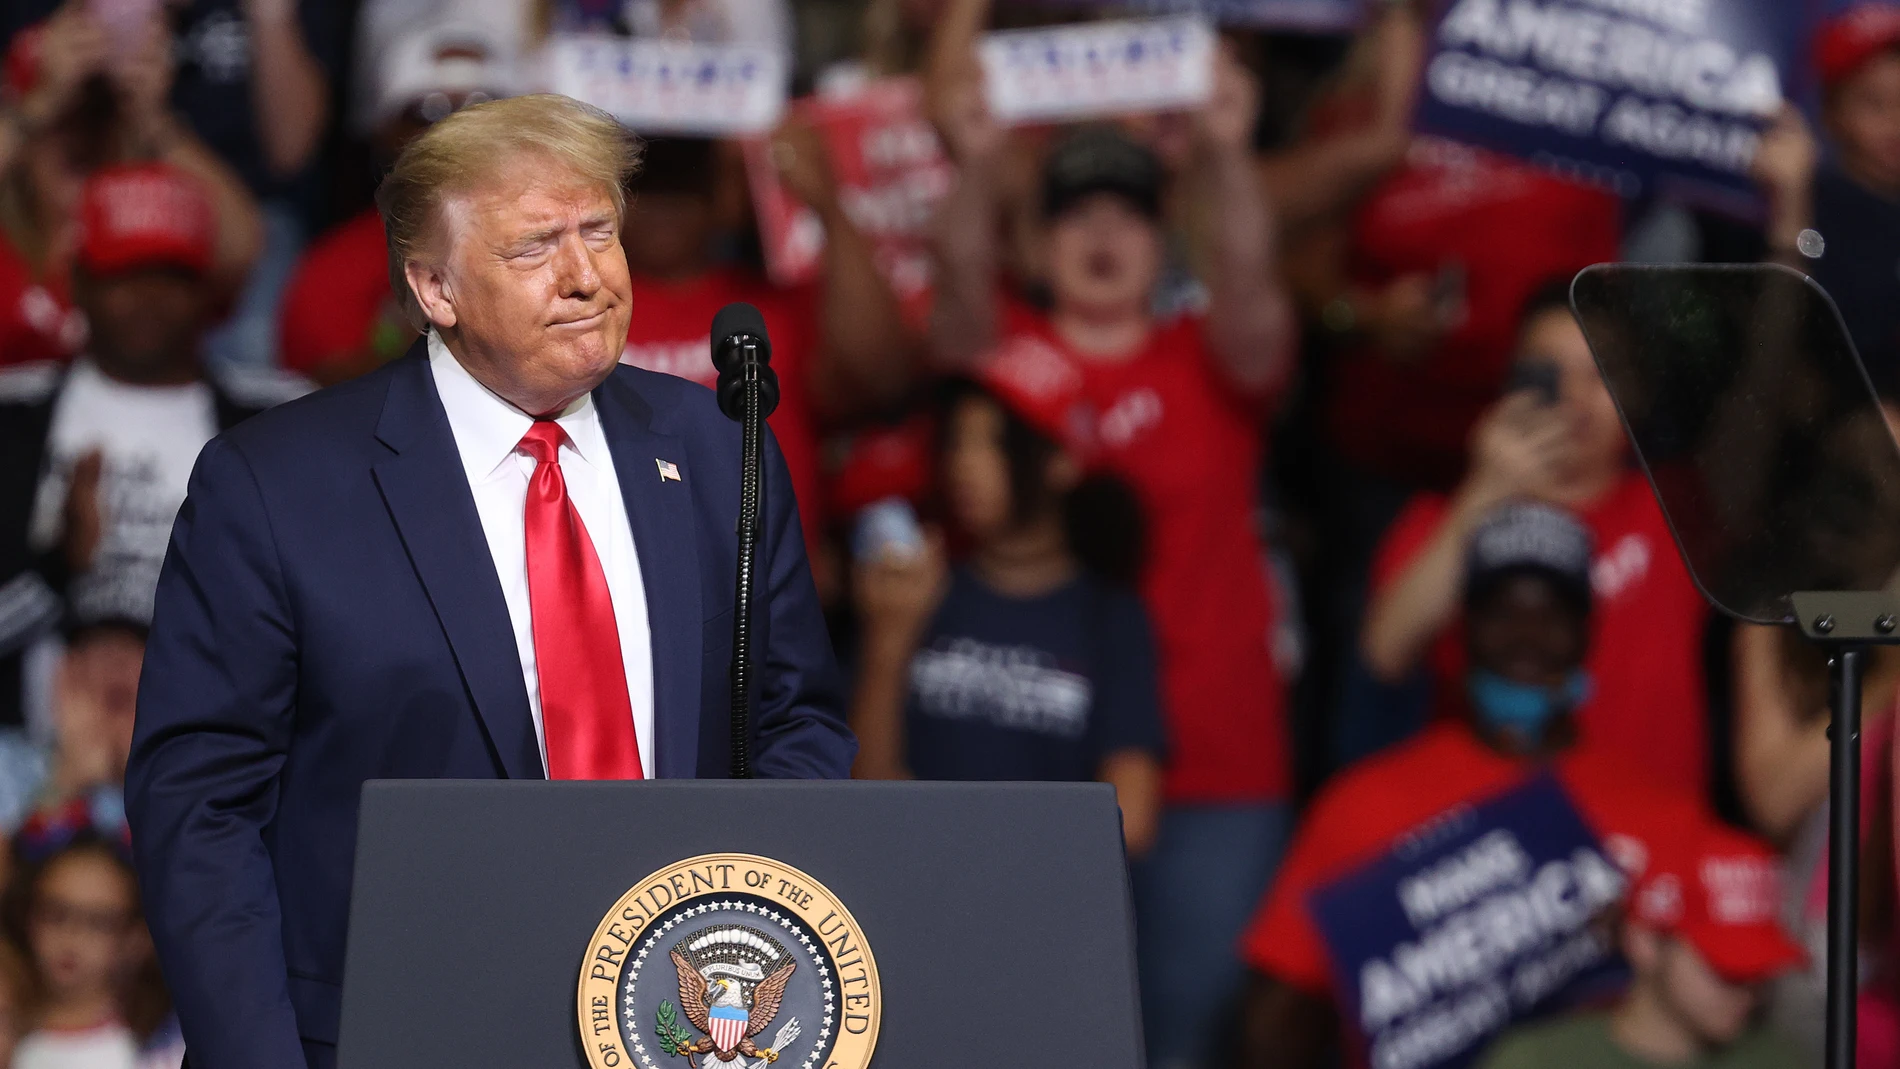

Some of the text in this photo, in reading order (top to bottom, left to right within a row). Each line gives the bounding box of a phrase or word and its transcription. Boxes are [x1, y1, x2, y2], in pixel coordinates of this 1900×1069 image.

[591, 864, 871, 1068] OF THE PRESIDENT OF THE UNITED
[708, 964, 741, 975] PLURIBUS
